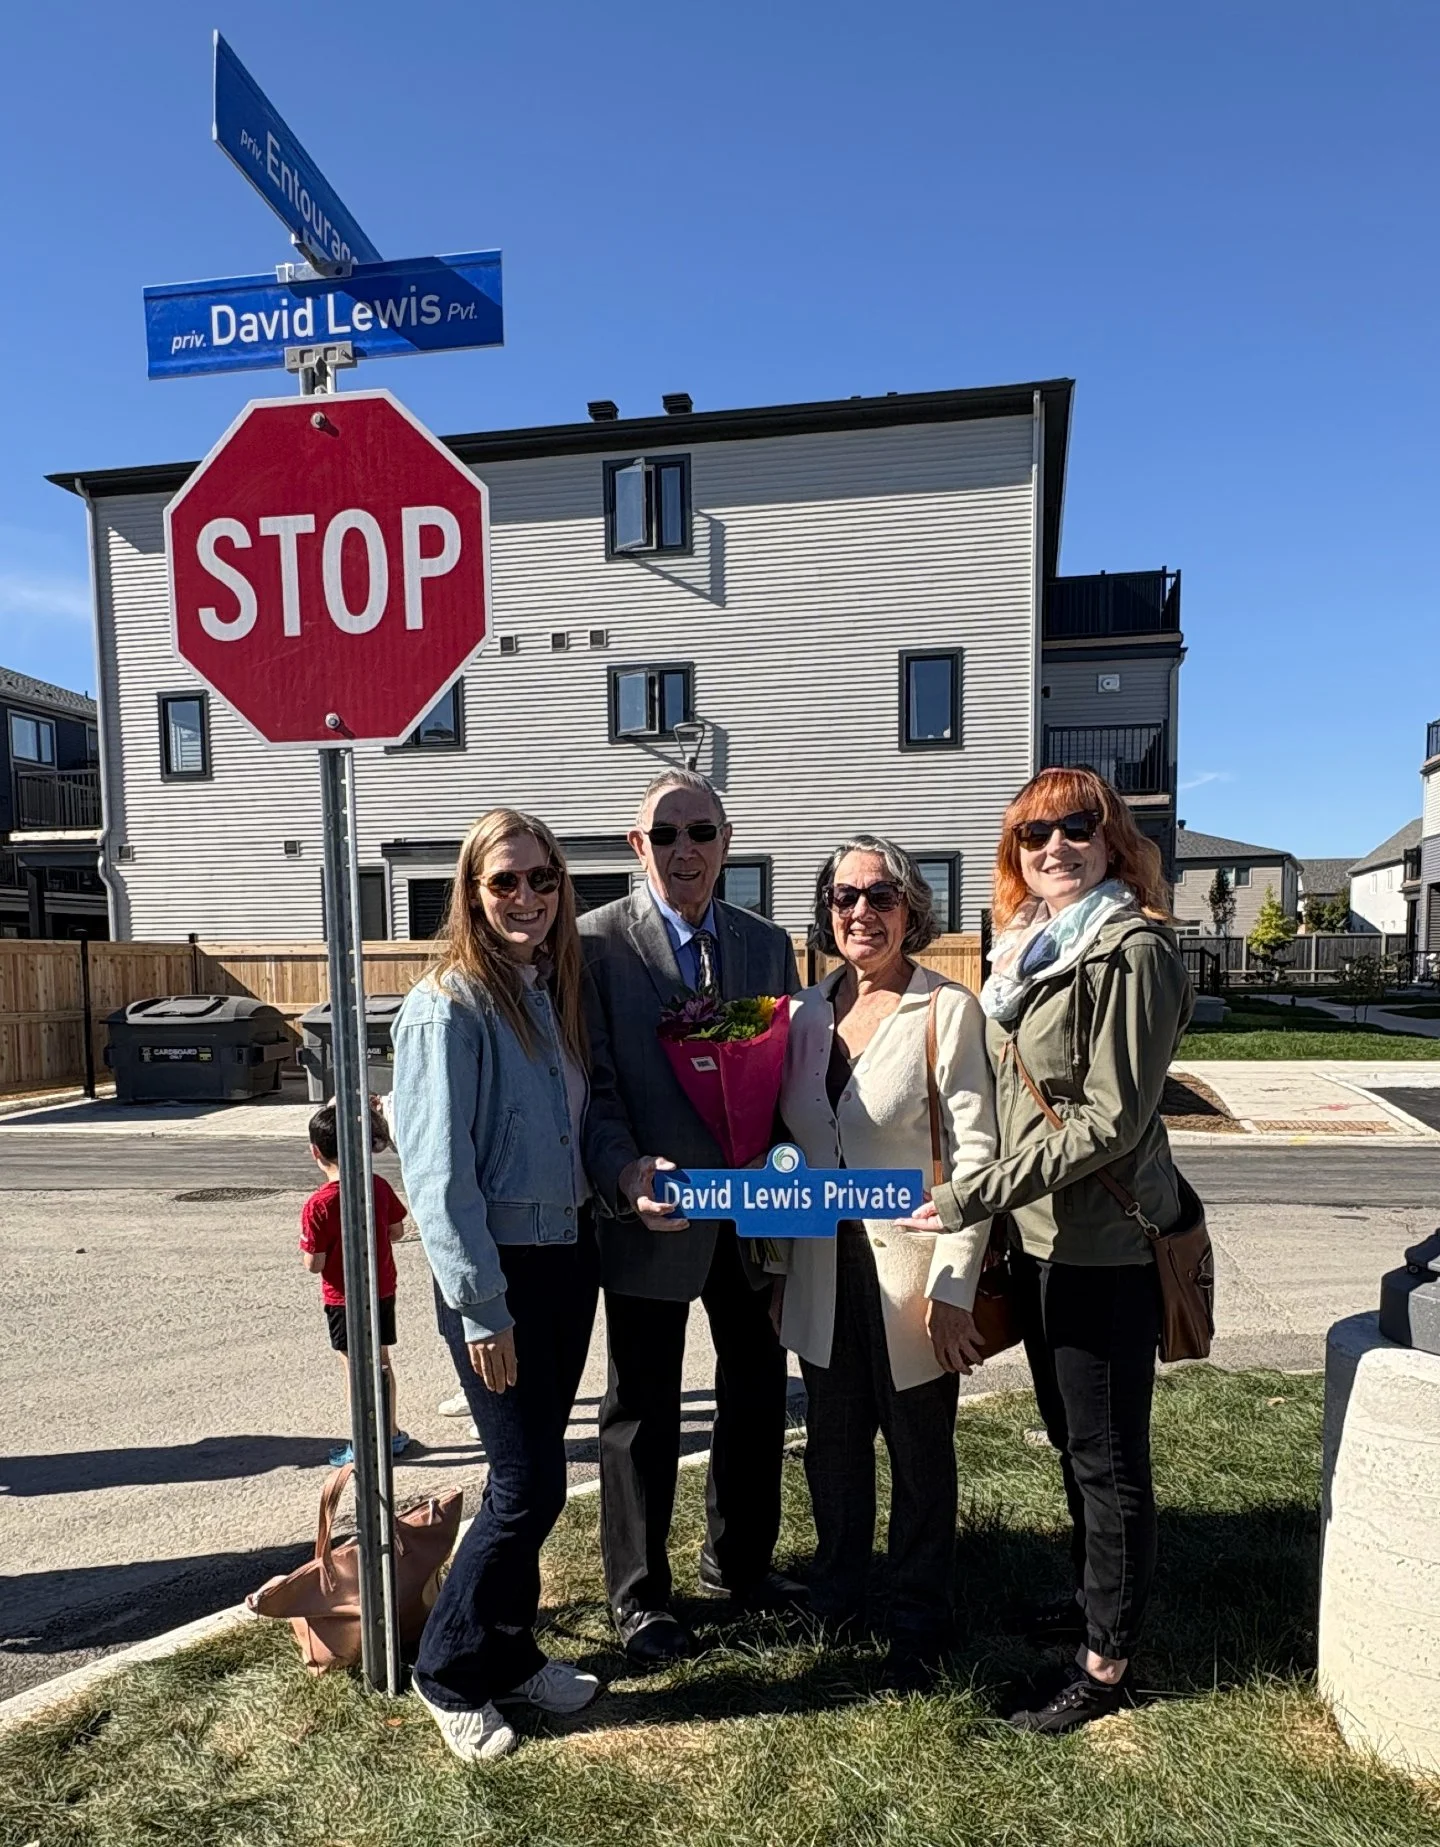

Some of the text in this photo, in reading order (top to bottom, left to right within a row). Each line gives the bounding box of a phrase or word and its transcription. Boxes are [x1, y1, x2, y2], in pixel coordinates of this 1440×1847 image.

[240, 128, 359, 265] priv. Entoura
[171, 285, 478, 354] priv. David Lewis Pvt.
[196, 505, 462, 642] STOP
[664, 1179, 912, 1210] David Lewis Private
